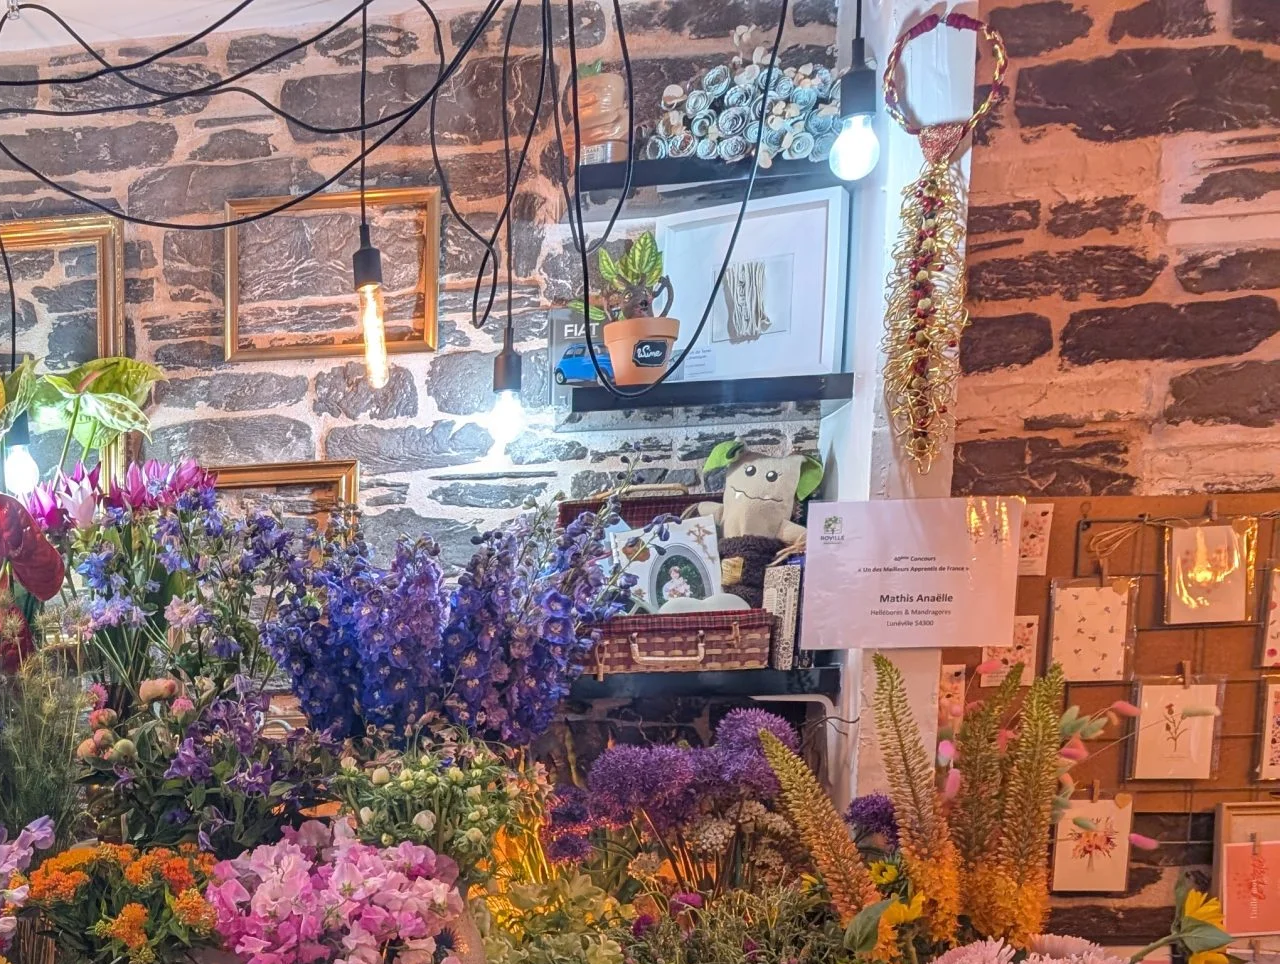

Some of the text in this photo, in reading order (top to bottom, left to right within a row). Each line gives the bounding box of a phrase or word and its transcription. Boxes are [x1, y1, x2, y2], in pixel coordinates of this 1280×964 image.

[564, 322, 600, 337] FIAT
[910, 565, 937, 573] Apprentis
[879, 593, 954, 603] Mathis Anaëlle
[911, 608, 951, 616] Mandragores
